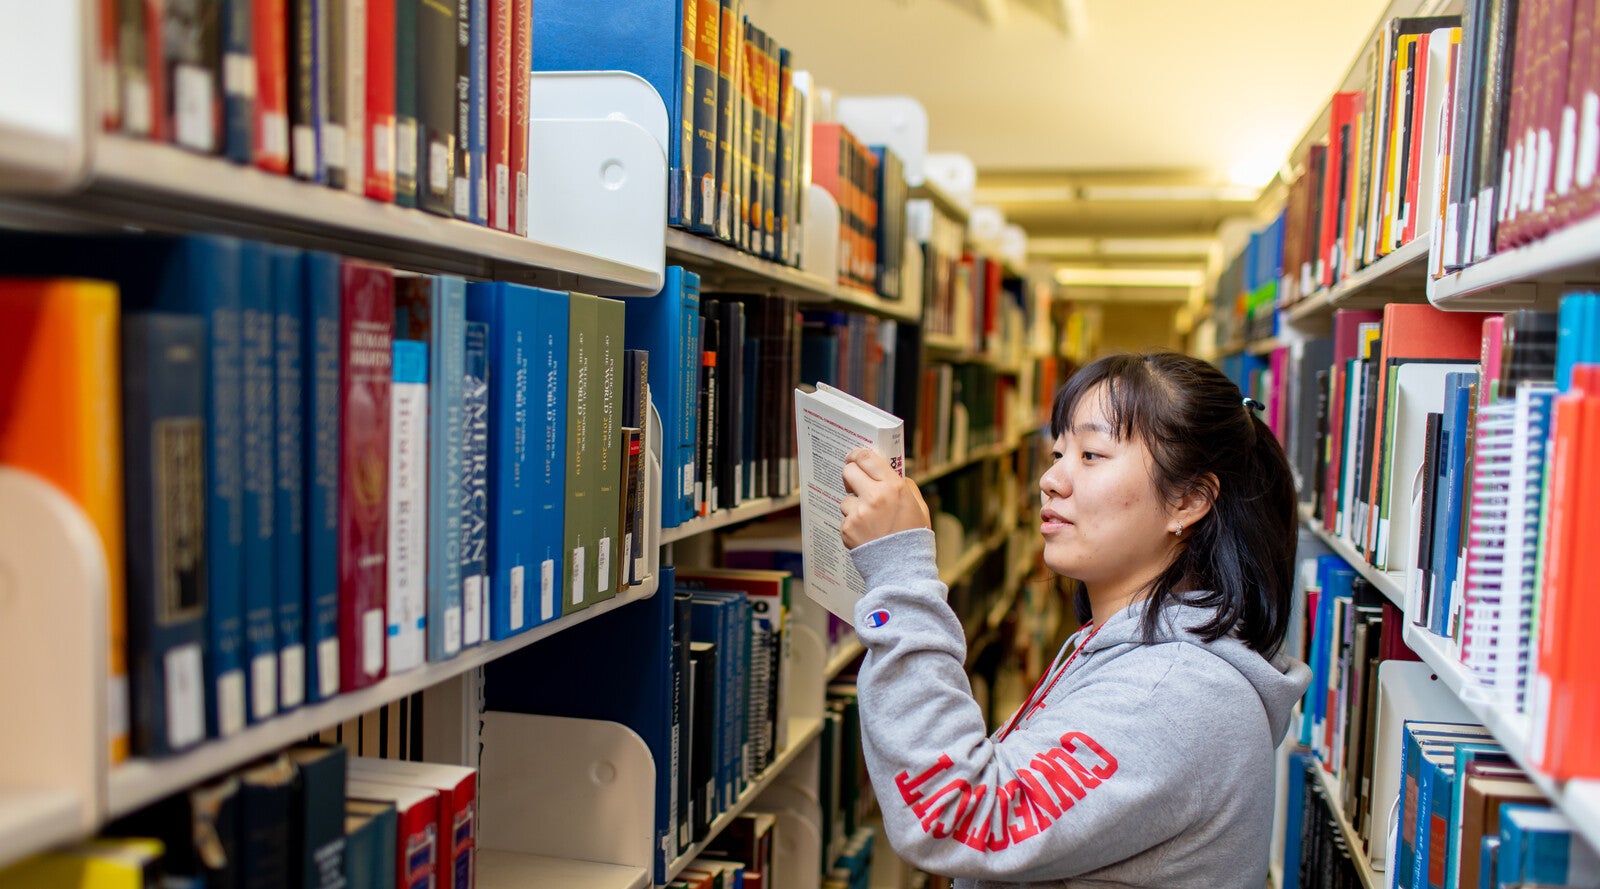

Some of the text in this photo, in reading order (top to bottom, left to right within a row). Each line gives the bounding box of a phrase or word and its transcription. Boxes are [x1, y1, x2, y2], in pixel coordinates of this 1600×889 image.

[496, 0, 507, 119] MUNICATION
[517, 0, 527, 128] MMUNICATION
[576, 366, 584, 416] WORLD
[602, 367, 610, 414] WORLD
[446, 405, 460, 509] HUMAN
[472, 376, 488, 562] AMERICAN
